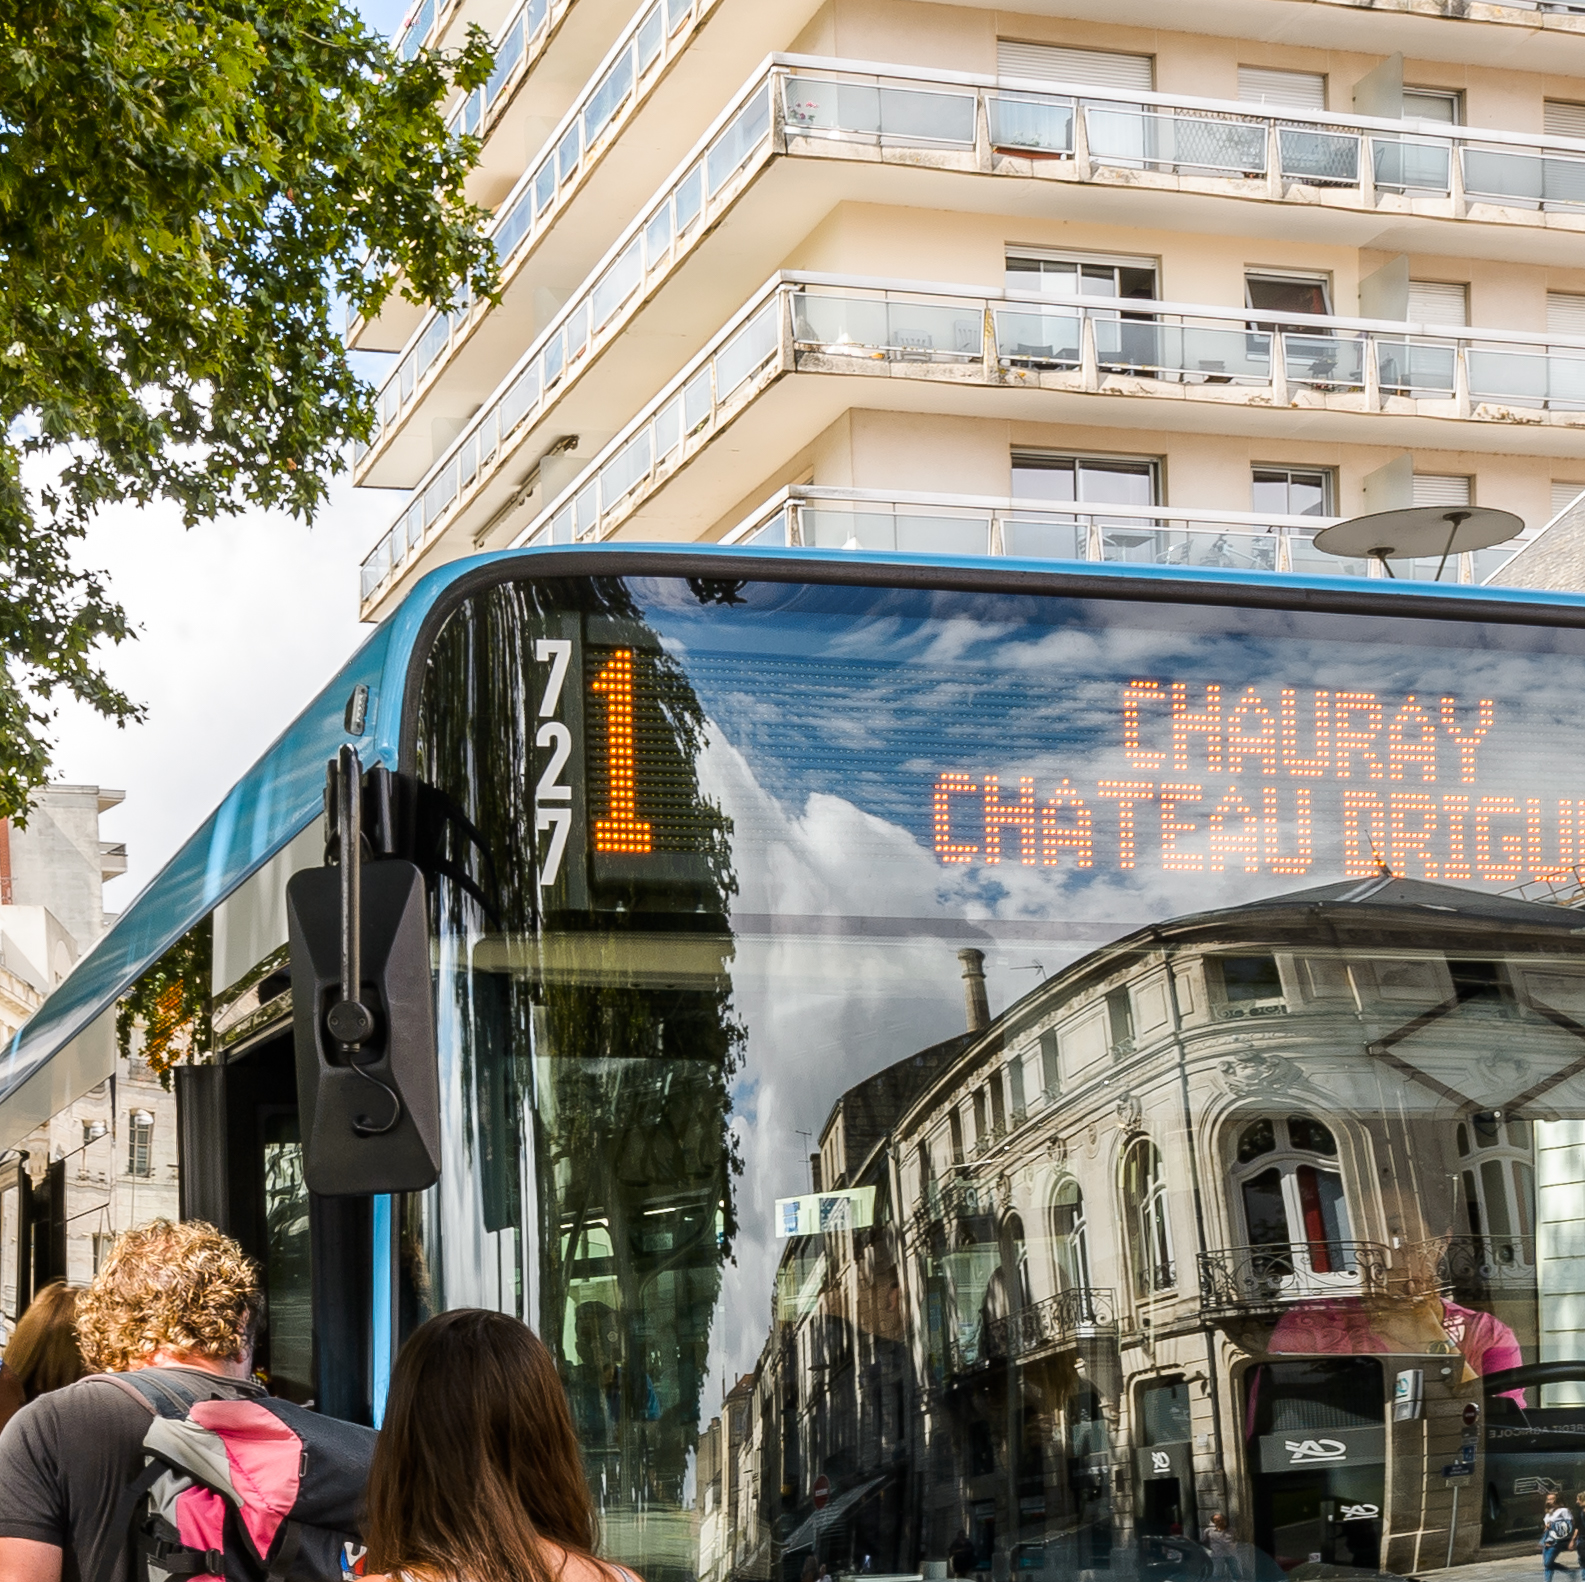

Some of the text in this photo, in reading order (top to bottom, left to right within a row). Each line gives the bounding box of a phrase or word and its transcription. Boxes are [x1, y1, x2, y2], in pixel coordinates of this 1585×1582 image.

[592, 649, 653, 855] 1
[1122, 679, 1495, 785] CHAURAY
[932, 773, 1313, 877] CHATEAU
